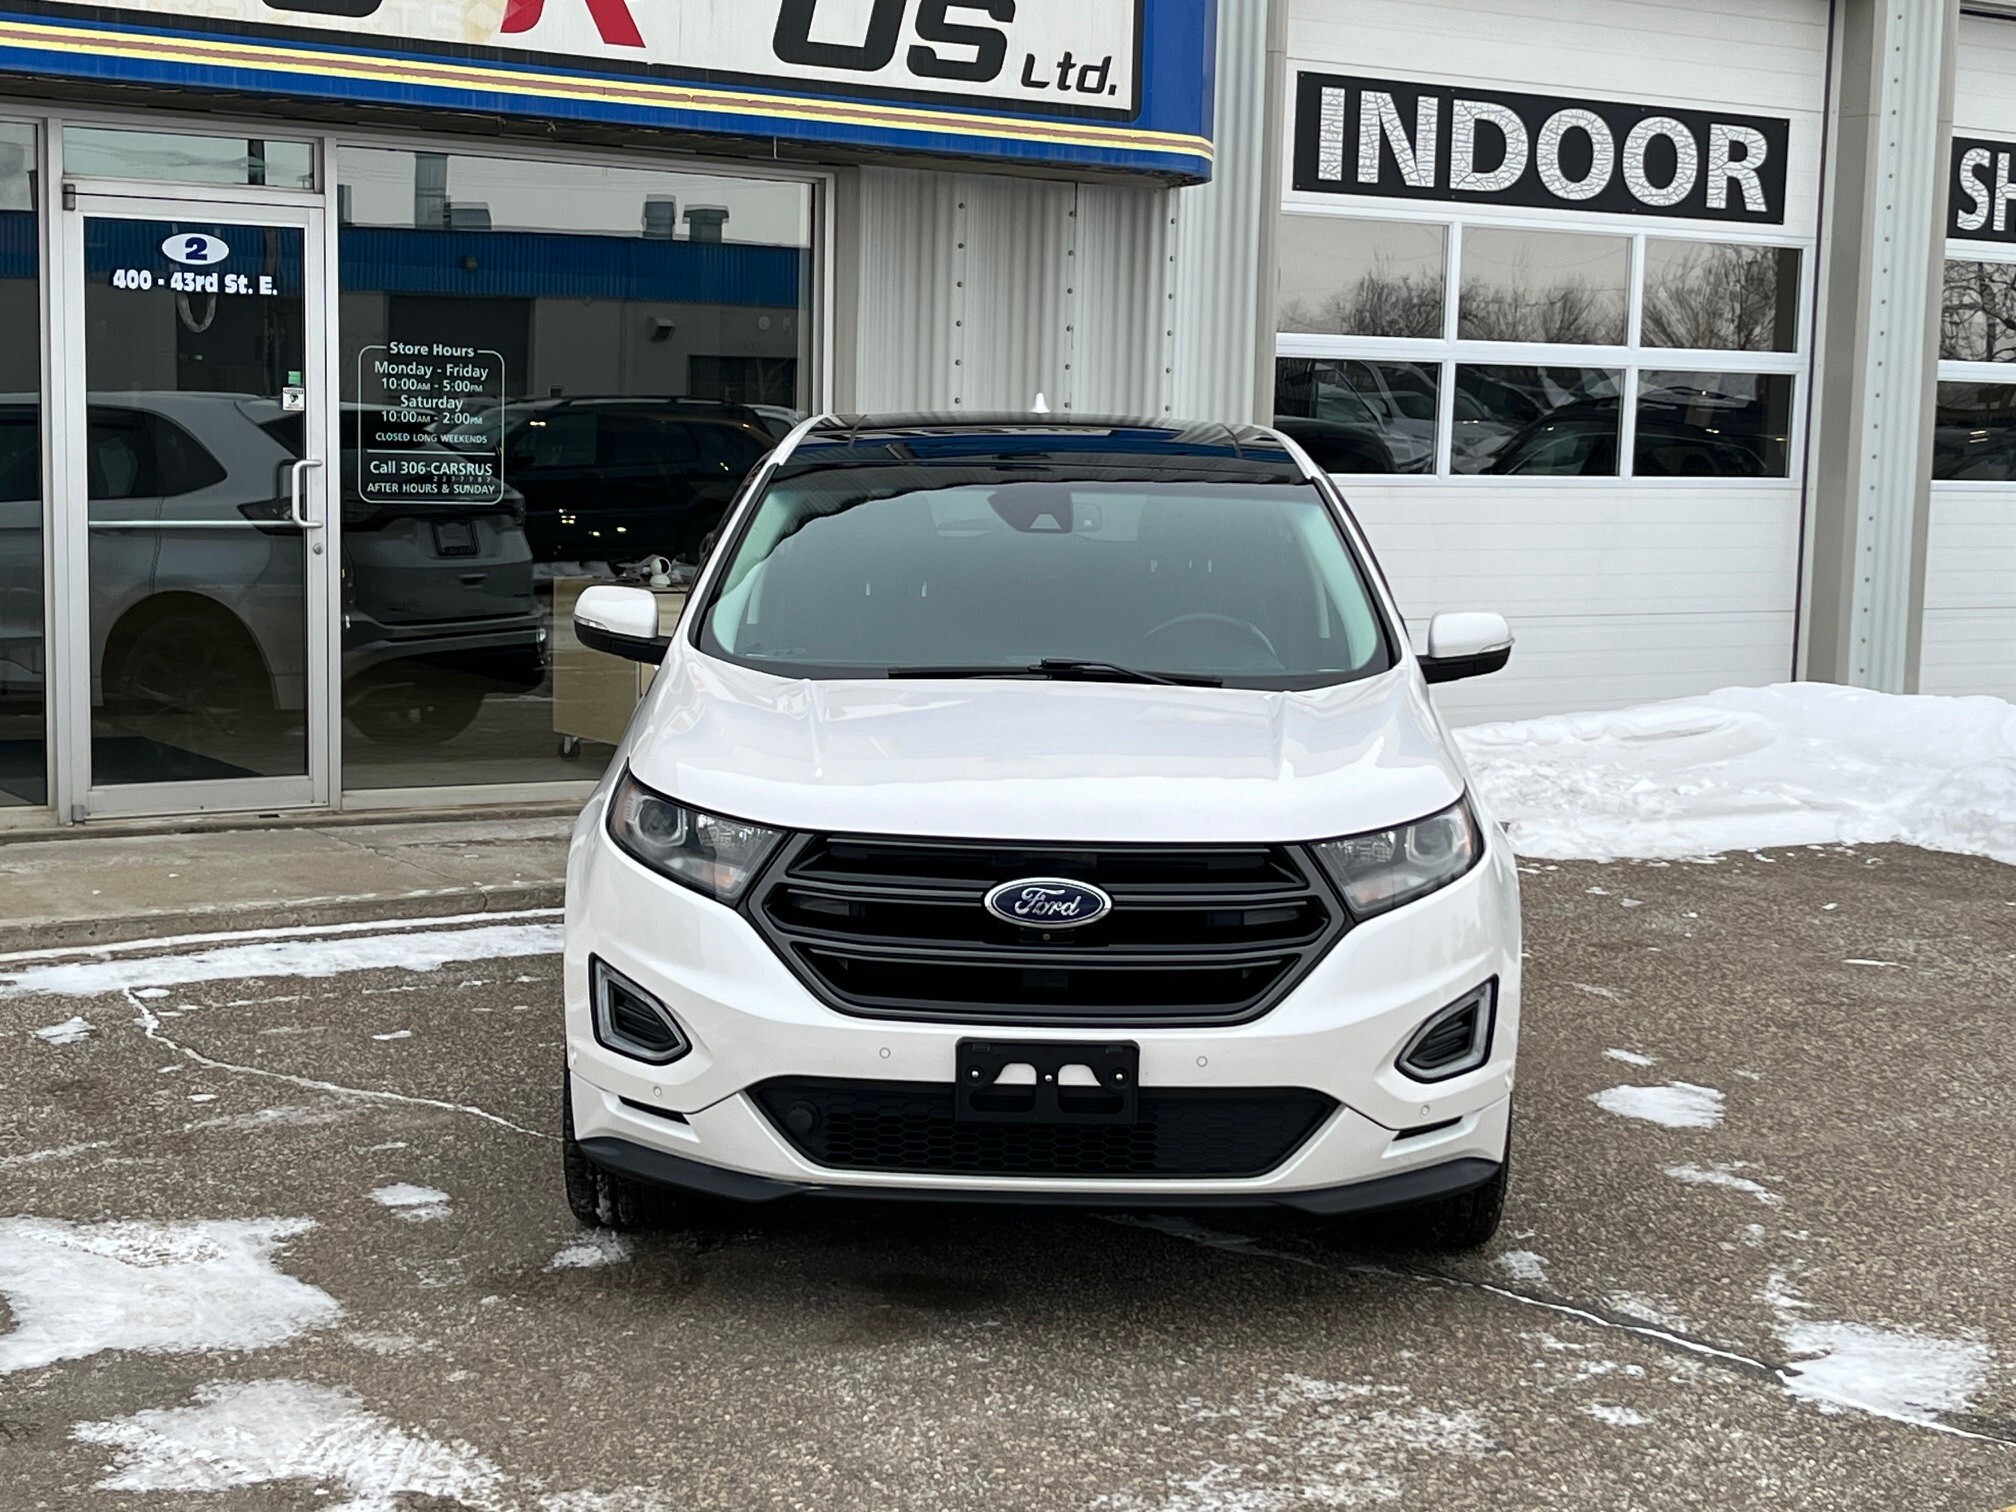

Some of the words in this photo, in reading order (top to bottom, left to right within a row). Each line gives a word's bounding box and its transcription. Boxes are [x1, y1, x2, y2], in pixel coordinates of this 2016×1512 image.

[1020, 51, 1118, 96] Ltd.
[1317, 86, 1770, 214] INDOOR
[184, 236, 208, 261] 2
[112, 268, 152, 290] 400
[170, 271, 219, 293] 43rd
[224, 273, 253, 295] St.
[259, 275, 278, 296] E.
[389, 341, 429, 355] Store
[433, 343, 475, 357] Hours
[374, 360, 433, 379] Monday
[446, 363, 489, 381] Friday
[400, 394, 464, 412] Saturday
[375, 432, 410, 442] CLOSED
[413, 433, 438, 442] LONG
[440, 434, 488, 444] WEEKENDS
[370, 460, 396, 474] Call
[400, 461, 493, 476] 306-CARSRUS
[366, 482, 399, 493] AFTER
[402, 483, 438, 494] HOURS
[441, 483, 450, 494] &
[453, 484, 495, 494] SUNDAY
[1014, 887, 1082, 916] Ford
